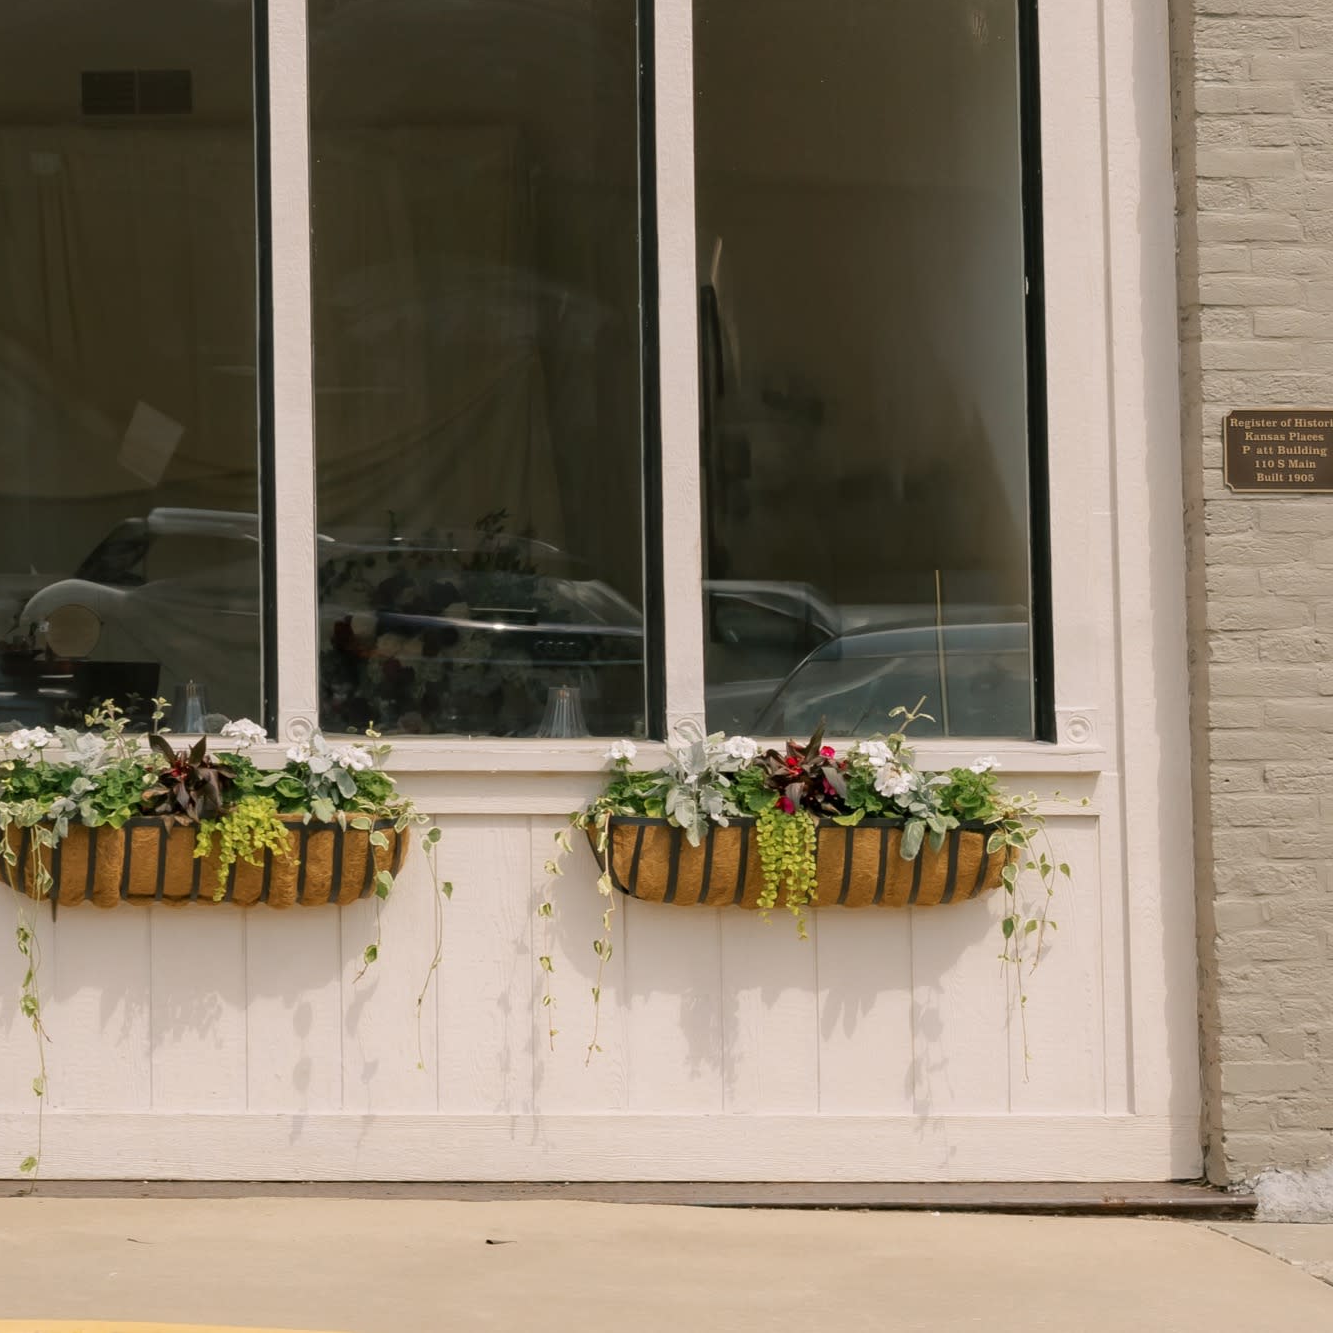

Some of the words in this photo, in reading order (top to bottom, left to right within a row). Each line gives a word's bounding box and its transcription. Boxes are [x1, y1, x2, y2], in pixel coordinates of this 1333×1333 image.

[1230, 418, 1278, 430] Register
[1280, 418, 1292, 428] of
[1244, 431, 1286, 441] Kansas
[1289, 432, 1325, 442] Places
[1277, 445, 1328, 457] Building
[1254, 459, 1275, 468] 110
[1277, 459, 1285, 469] S
[1288, 459, 1317, 469] Main
[1256, 473, 1284, 482] Built
[1288, 473, 1315, 483] 1905
